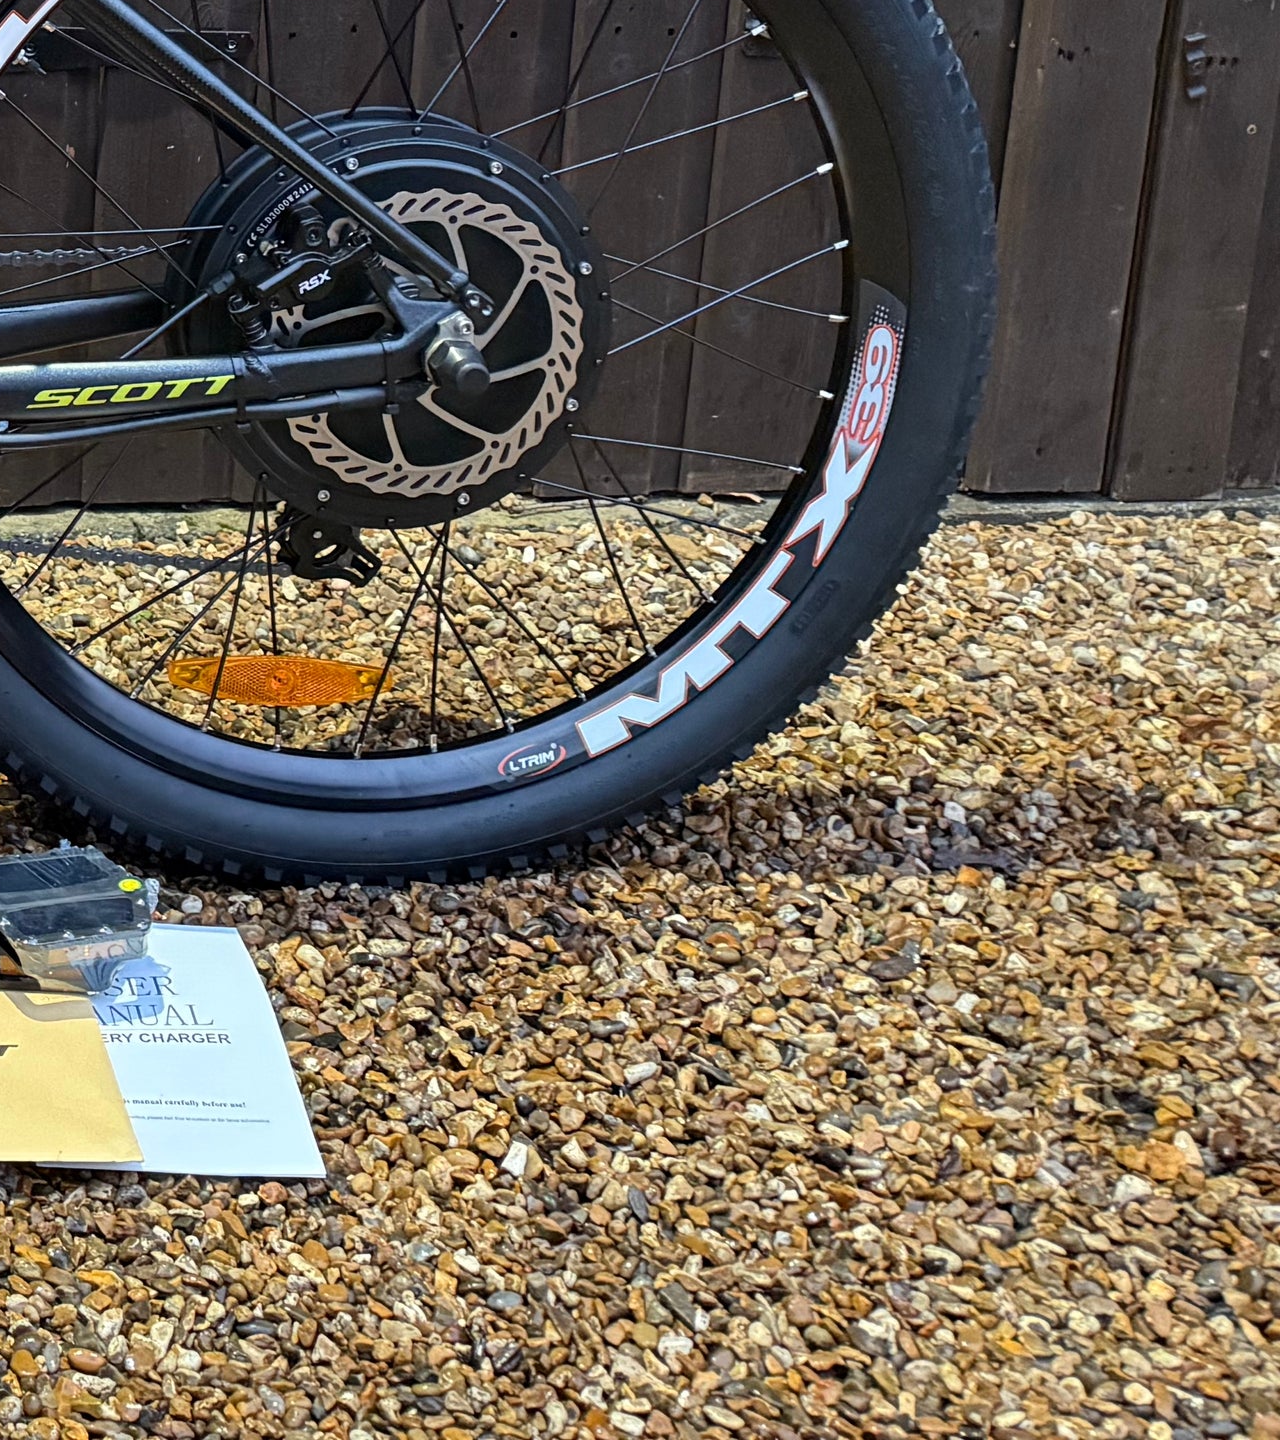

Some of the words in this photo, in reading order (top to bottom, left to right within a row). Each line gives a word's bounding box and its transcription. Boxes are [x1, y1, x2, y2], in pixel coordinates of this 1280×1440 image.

[298, 269, 331, 295] RSX
[26, 374, 235, 409] SCOTT
[509, 750, 555, 772] LTRIM
[104, 976, 179, 997] SER
[92, 1004, 214, 1026] ANUAL
[101, 1033, 133, 1043] ERY
[139, 1033, 231, 1044] CHARGER
